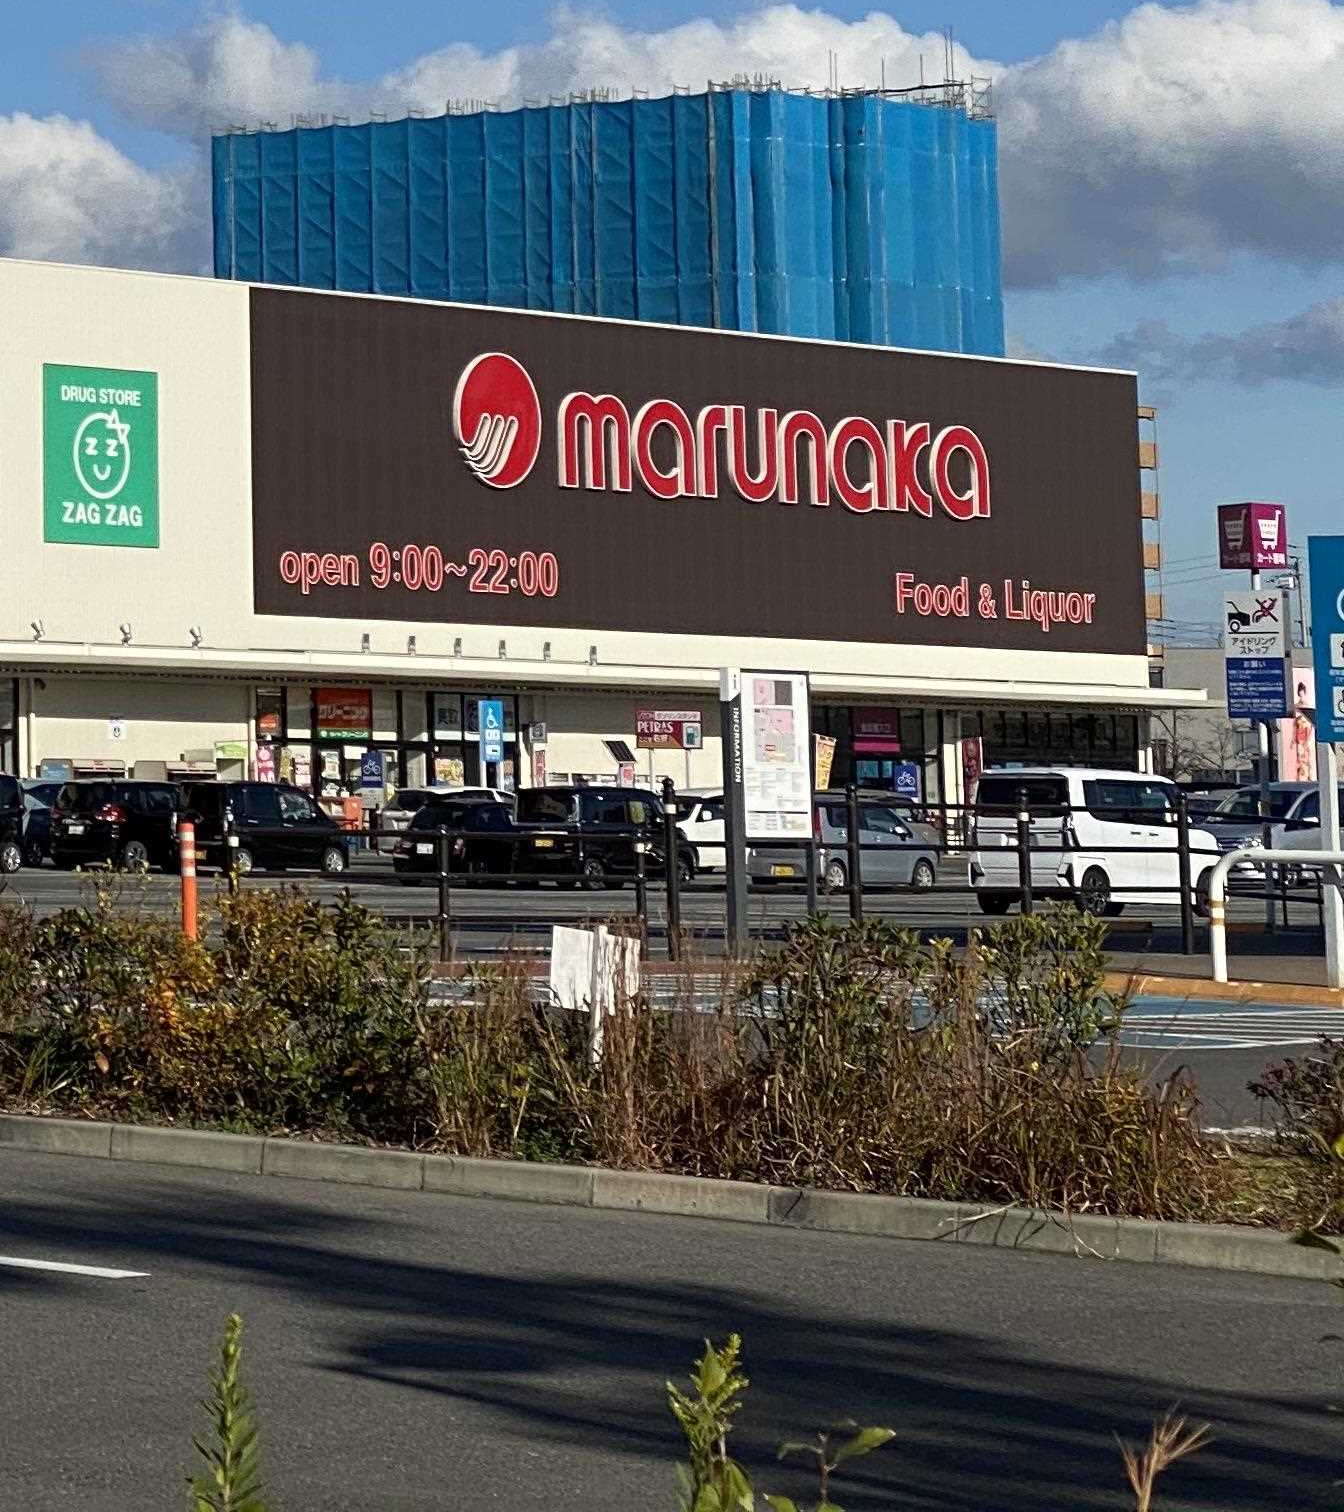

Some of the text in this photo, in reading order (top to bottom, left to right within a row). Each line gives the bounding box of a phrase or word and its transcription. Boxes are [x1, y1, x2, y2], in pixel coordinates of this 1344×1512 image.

[61, 384, 141, 406] DRUG STORE
[558, 391, 992, 520] marunaka
[62, 502, 143, 528] ZAG ZAG
[280, 551, 360, 594] open
[896, 573, 1096, 631] Food & Liquor
[733, 707, 742, 783] INFORMATION
